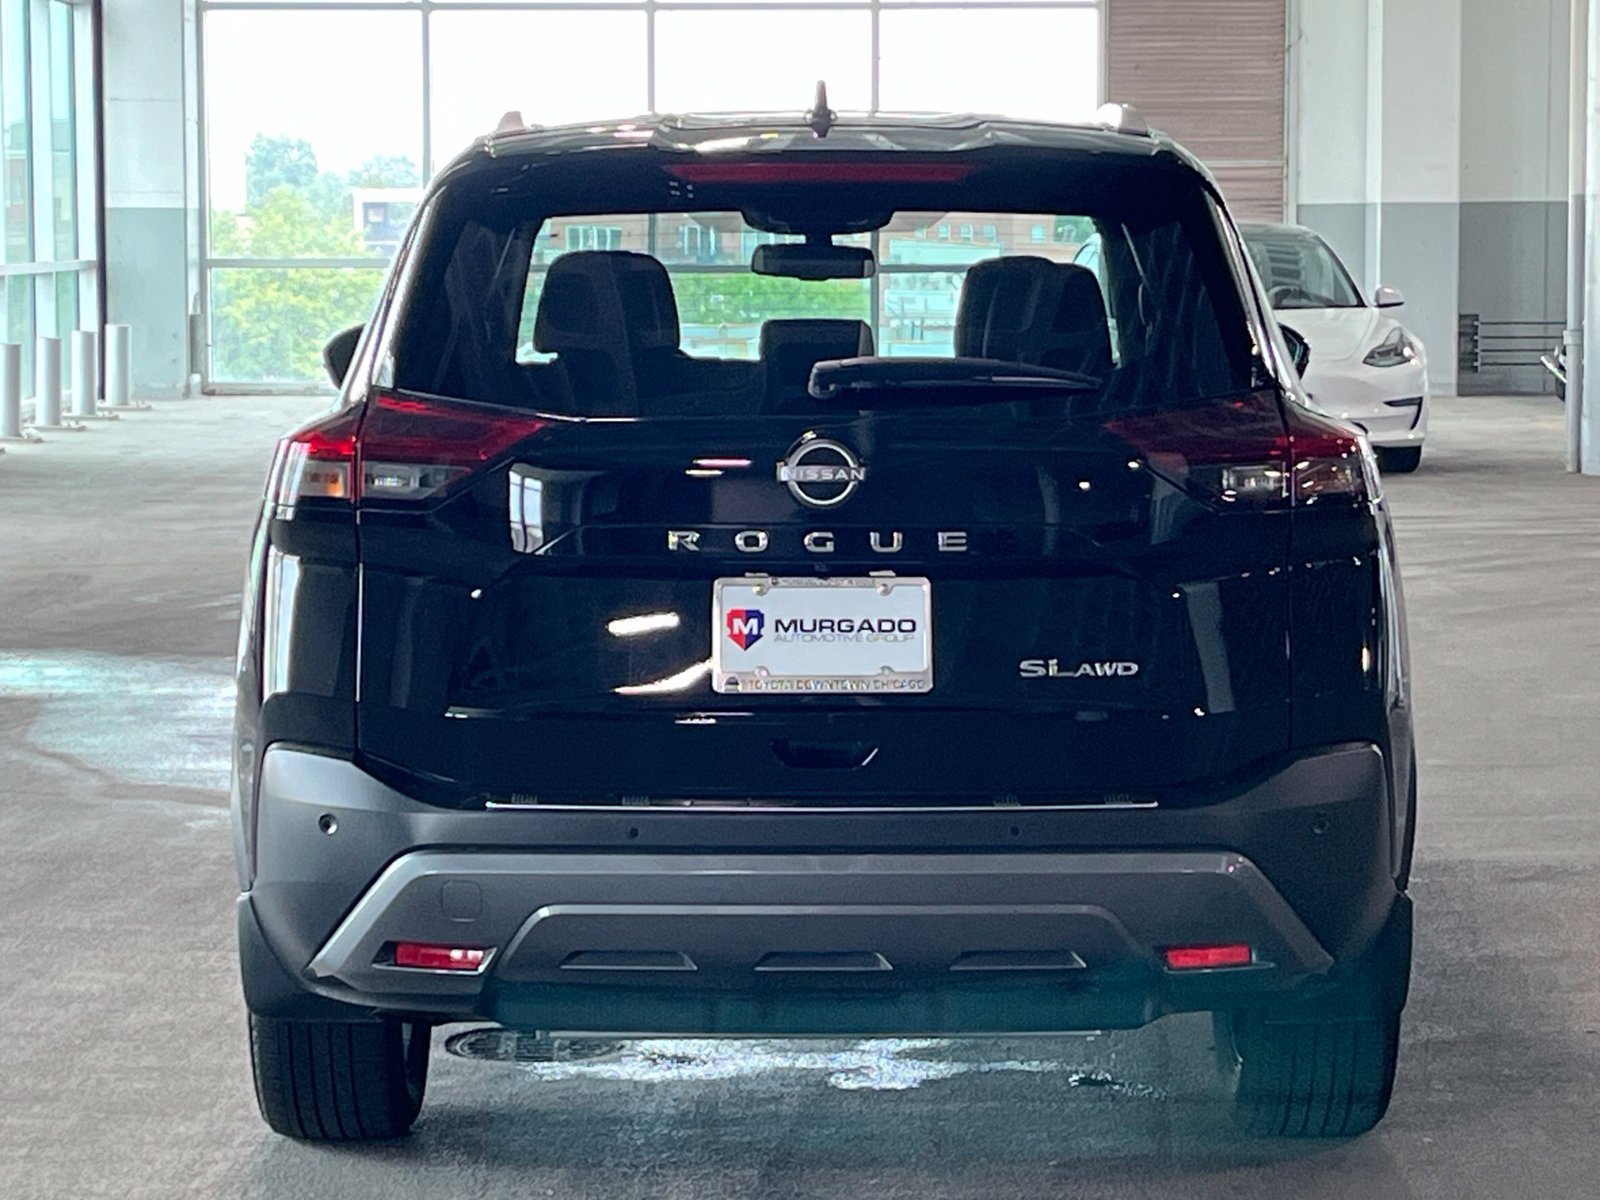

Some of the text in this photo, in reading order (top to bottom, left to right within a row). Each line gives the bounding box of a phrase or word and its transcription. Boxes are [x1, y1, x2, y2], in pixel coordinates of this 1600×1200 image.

[782, 467, 865, 481] NISSAN
[668, 530, 967, 553] ROGUE
[774, 619, 917, 633] MURGADO
[774, 633, 915, 643] AUTOMOTIVE GROUP
